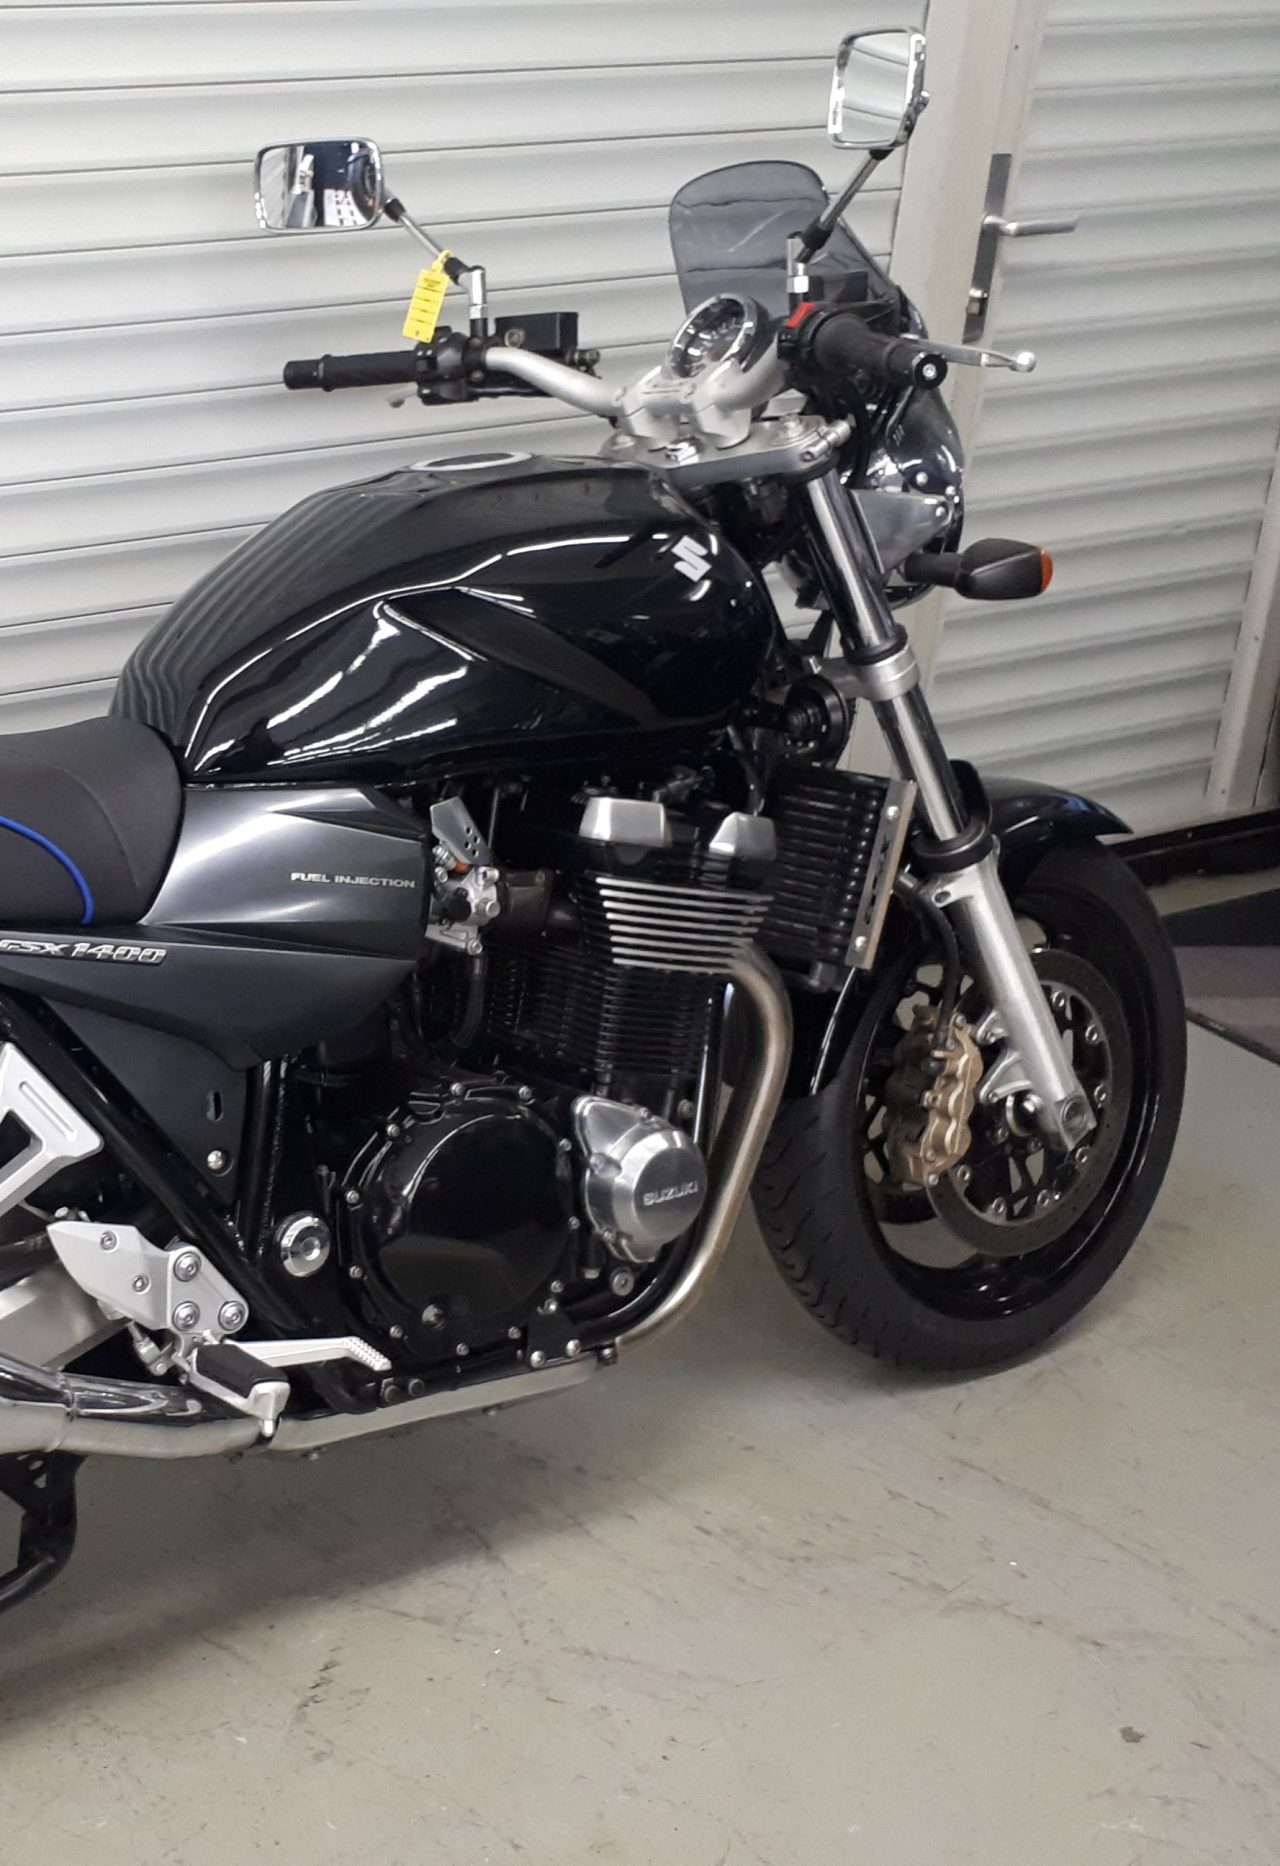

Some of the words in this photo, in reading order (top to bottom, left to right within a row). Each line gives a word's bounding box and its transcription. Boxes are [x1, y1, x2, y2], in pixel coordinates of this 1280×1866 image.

[290, 872, 331, 883] FUEL
[334, 875, 416, 888] INJECTION
[642, 1180, 699, 1206] SUZUKI
